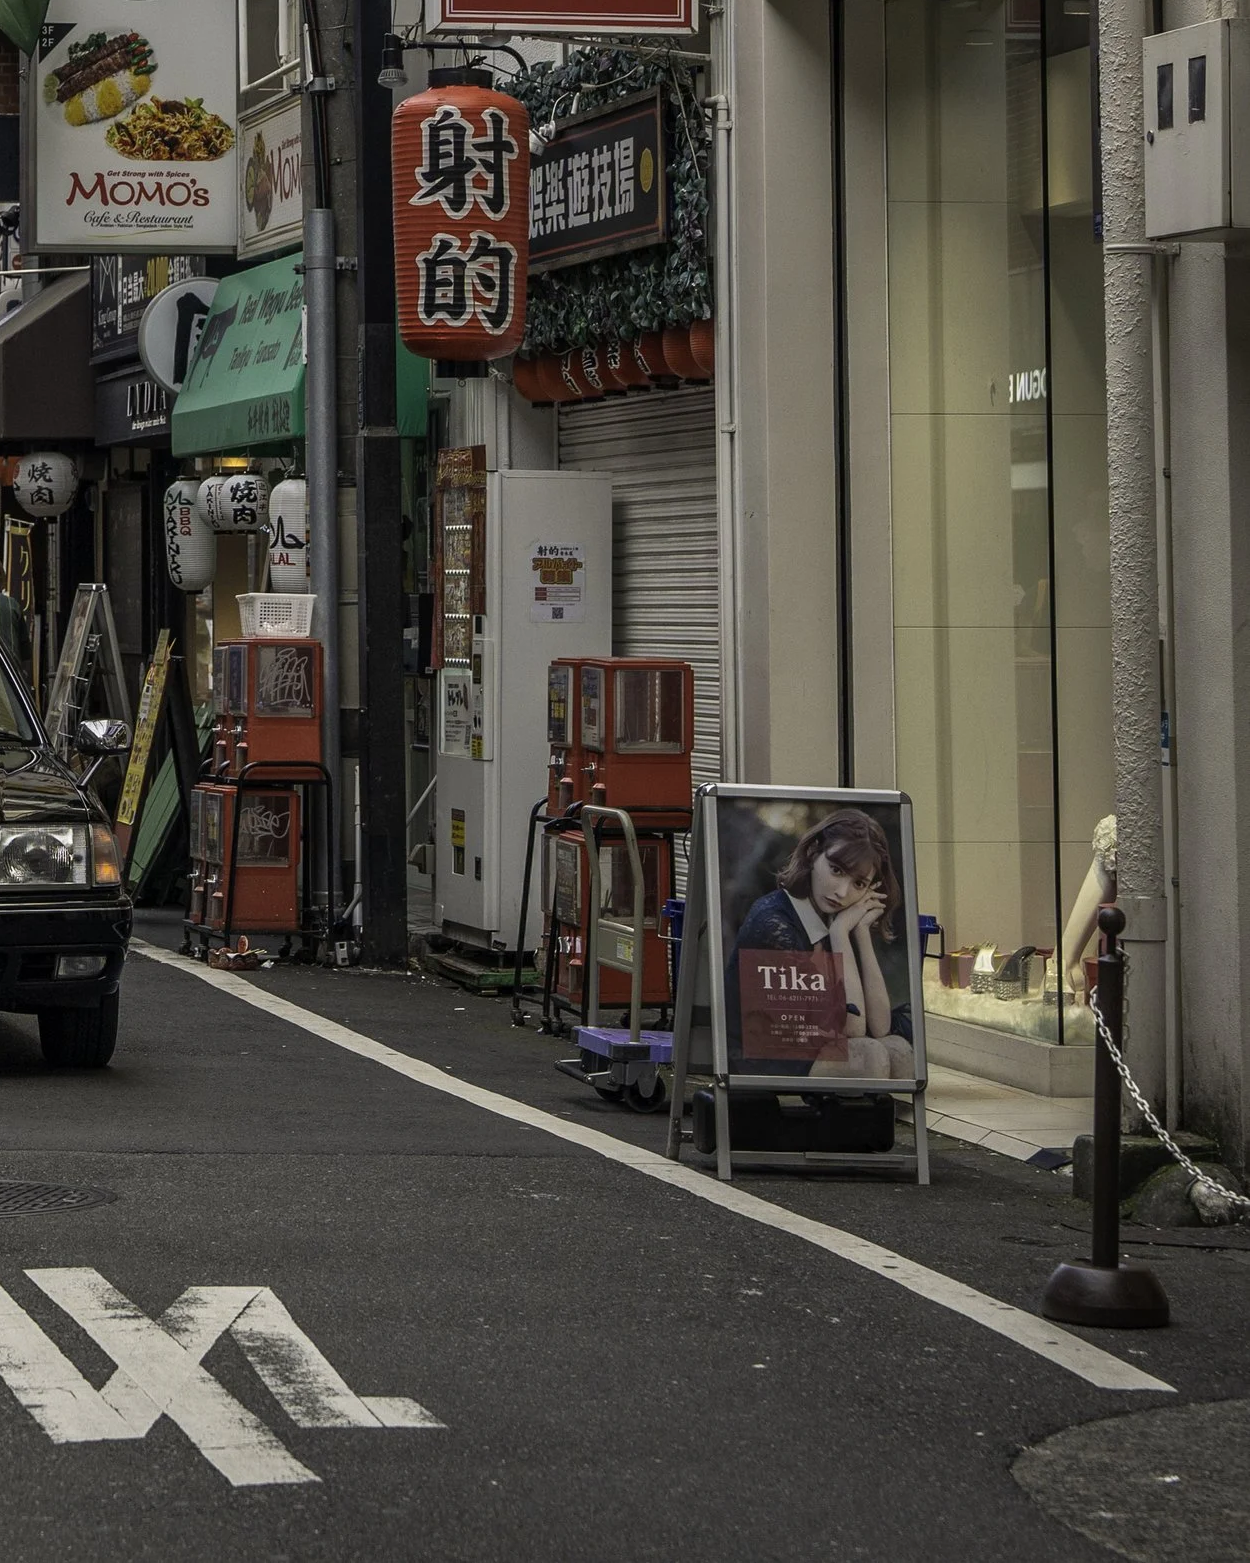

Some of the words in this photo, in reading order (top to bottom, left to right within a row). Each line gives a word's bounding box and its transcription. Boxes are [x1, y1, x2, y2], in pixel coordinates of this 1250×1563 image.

[42, 26, 54, 35] 3F
[42, 38, 54, 47] 2F
[107, 170, 120, 178] Get
[122, 170, 146, 179] Strong
[148, 170, 164, 178] with
[166, 171, 190, 180] Spices
[270, 145, 302, 203] MOM
[83, 210, 112, 228] Cafe
[114, 213, 126, 224] &
[126, 209, 194, 225] Restaurant
[408, 105, 518, 335] 射的
[27, 462, 54, 506] 焼肉
[230, 481, 258, 525] 焼肉
[180, 507, 192, 536] BBQ
[166, 506, 183, 585] YAKINIKU
[757, 965, 827, 991] Tika
